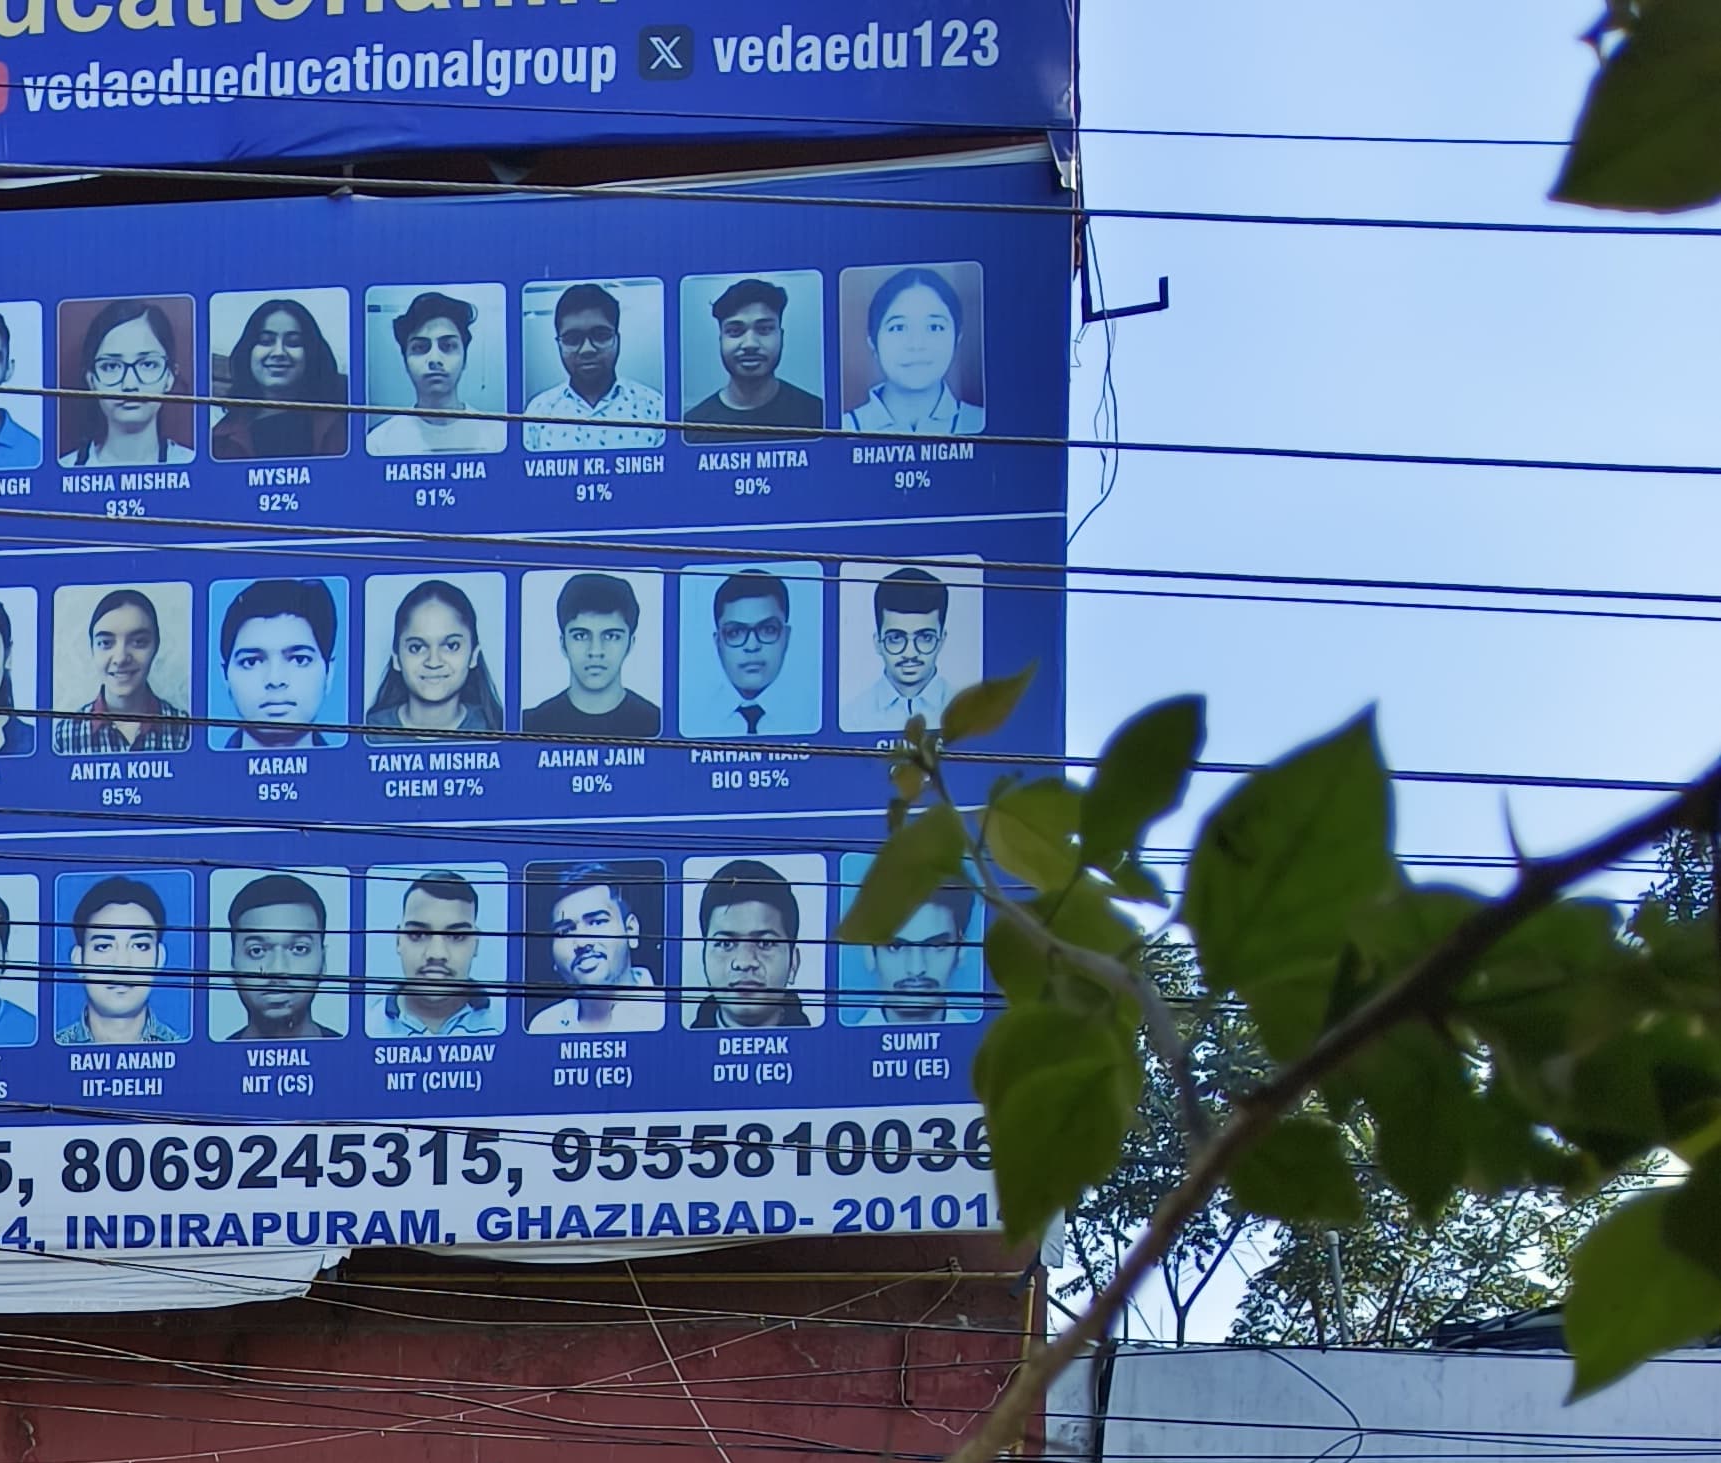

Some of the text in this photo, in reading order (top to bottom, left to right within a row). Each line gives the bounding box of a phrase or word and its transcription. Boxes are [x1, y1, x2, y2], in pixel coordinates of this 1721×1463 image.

[23, 39, 616, 112] vedaedueducationalgroup
[712, 19, 1000, 73] vedaedu123
[698, 449, 809, 471] AKASH MITRA
[852, 442, 974, 466] BHAVYA NIGAM
[248, 466, 310, 487] MYSHA
[385, 460, 487, 482] HARSH JHA
[524, 454, 665, 478] VARUN KR. SINGH
[62, 471, 191, 493] NISHA MISHRA
[734, 476, 771, 496] 90%
[894, 469, 931, 490] 90%
[259, 492, 298, 512] 92%
[415, 486, 456, 506] 91%
[576, 482, 613, 502] 91%
[106, 499, 145, 518] 93%
[248, 756, 308, 776] KARAN
[368, 750, 501, 773] TANYA MISHRA
[538, 747, 646, 768] AAHAN JAIN
[71, 760, 173, 782] ANITA KOUL
[711, 769, 789, 789] BIO 95%
[258, 782, 298, 802] 95%
[384, 776, 484, 798] CHEM 97%
[571, 773, 613, 794] 90%
[102, 787, 142, 807] 95%
[560, 1040, 627, 1061] NIRESH
[719, 1036, 789, 1057] DEEPAK
[882, 1032, 941, 1052] SUMIT
[70, 1050, 176, 1072] RAVI ANAND
[247, 1048, 310, 1068] VISHAL
[374, 1043, 496, 1066] SURAJ YADAV
[553, 1066, 633, 1090] DTU (EC)
[713, 1061, 793, 1085] DTU (EC)
[872, 1057, 951, 1081] DTU (EE)
[82, 1078, 163, 1098] IIT-DELHI
[242, 1073, 315, 1097] NIT (CS)
[386, 1069, 482, 1093] NIT (CIVIL)
[61, 1128, 524, 1198] 8069245315,
[66, 1208, 457, 1251] INDIRAPURAM,
[475, 1201, 815, 1242] GHAZIABAD-
[832, 1193, 1004, 1234] 20101
